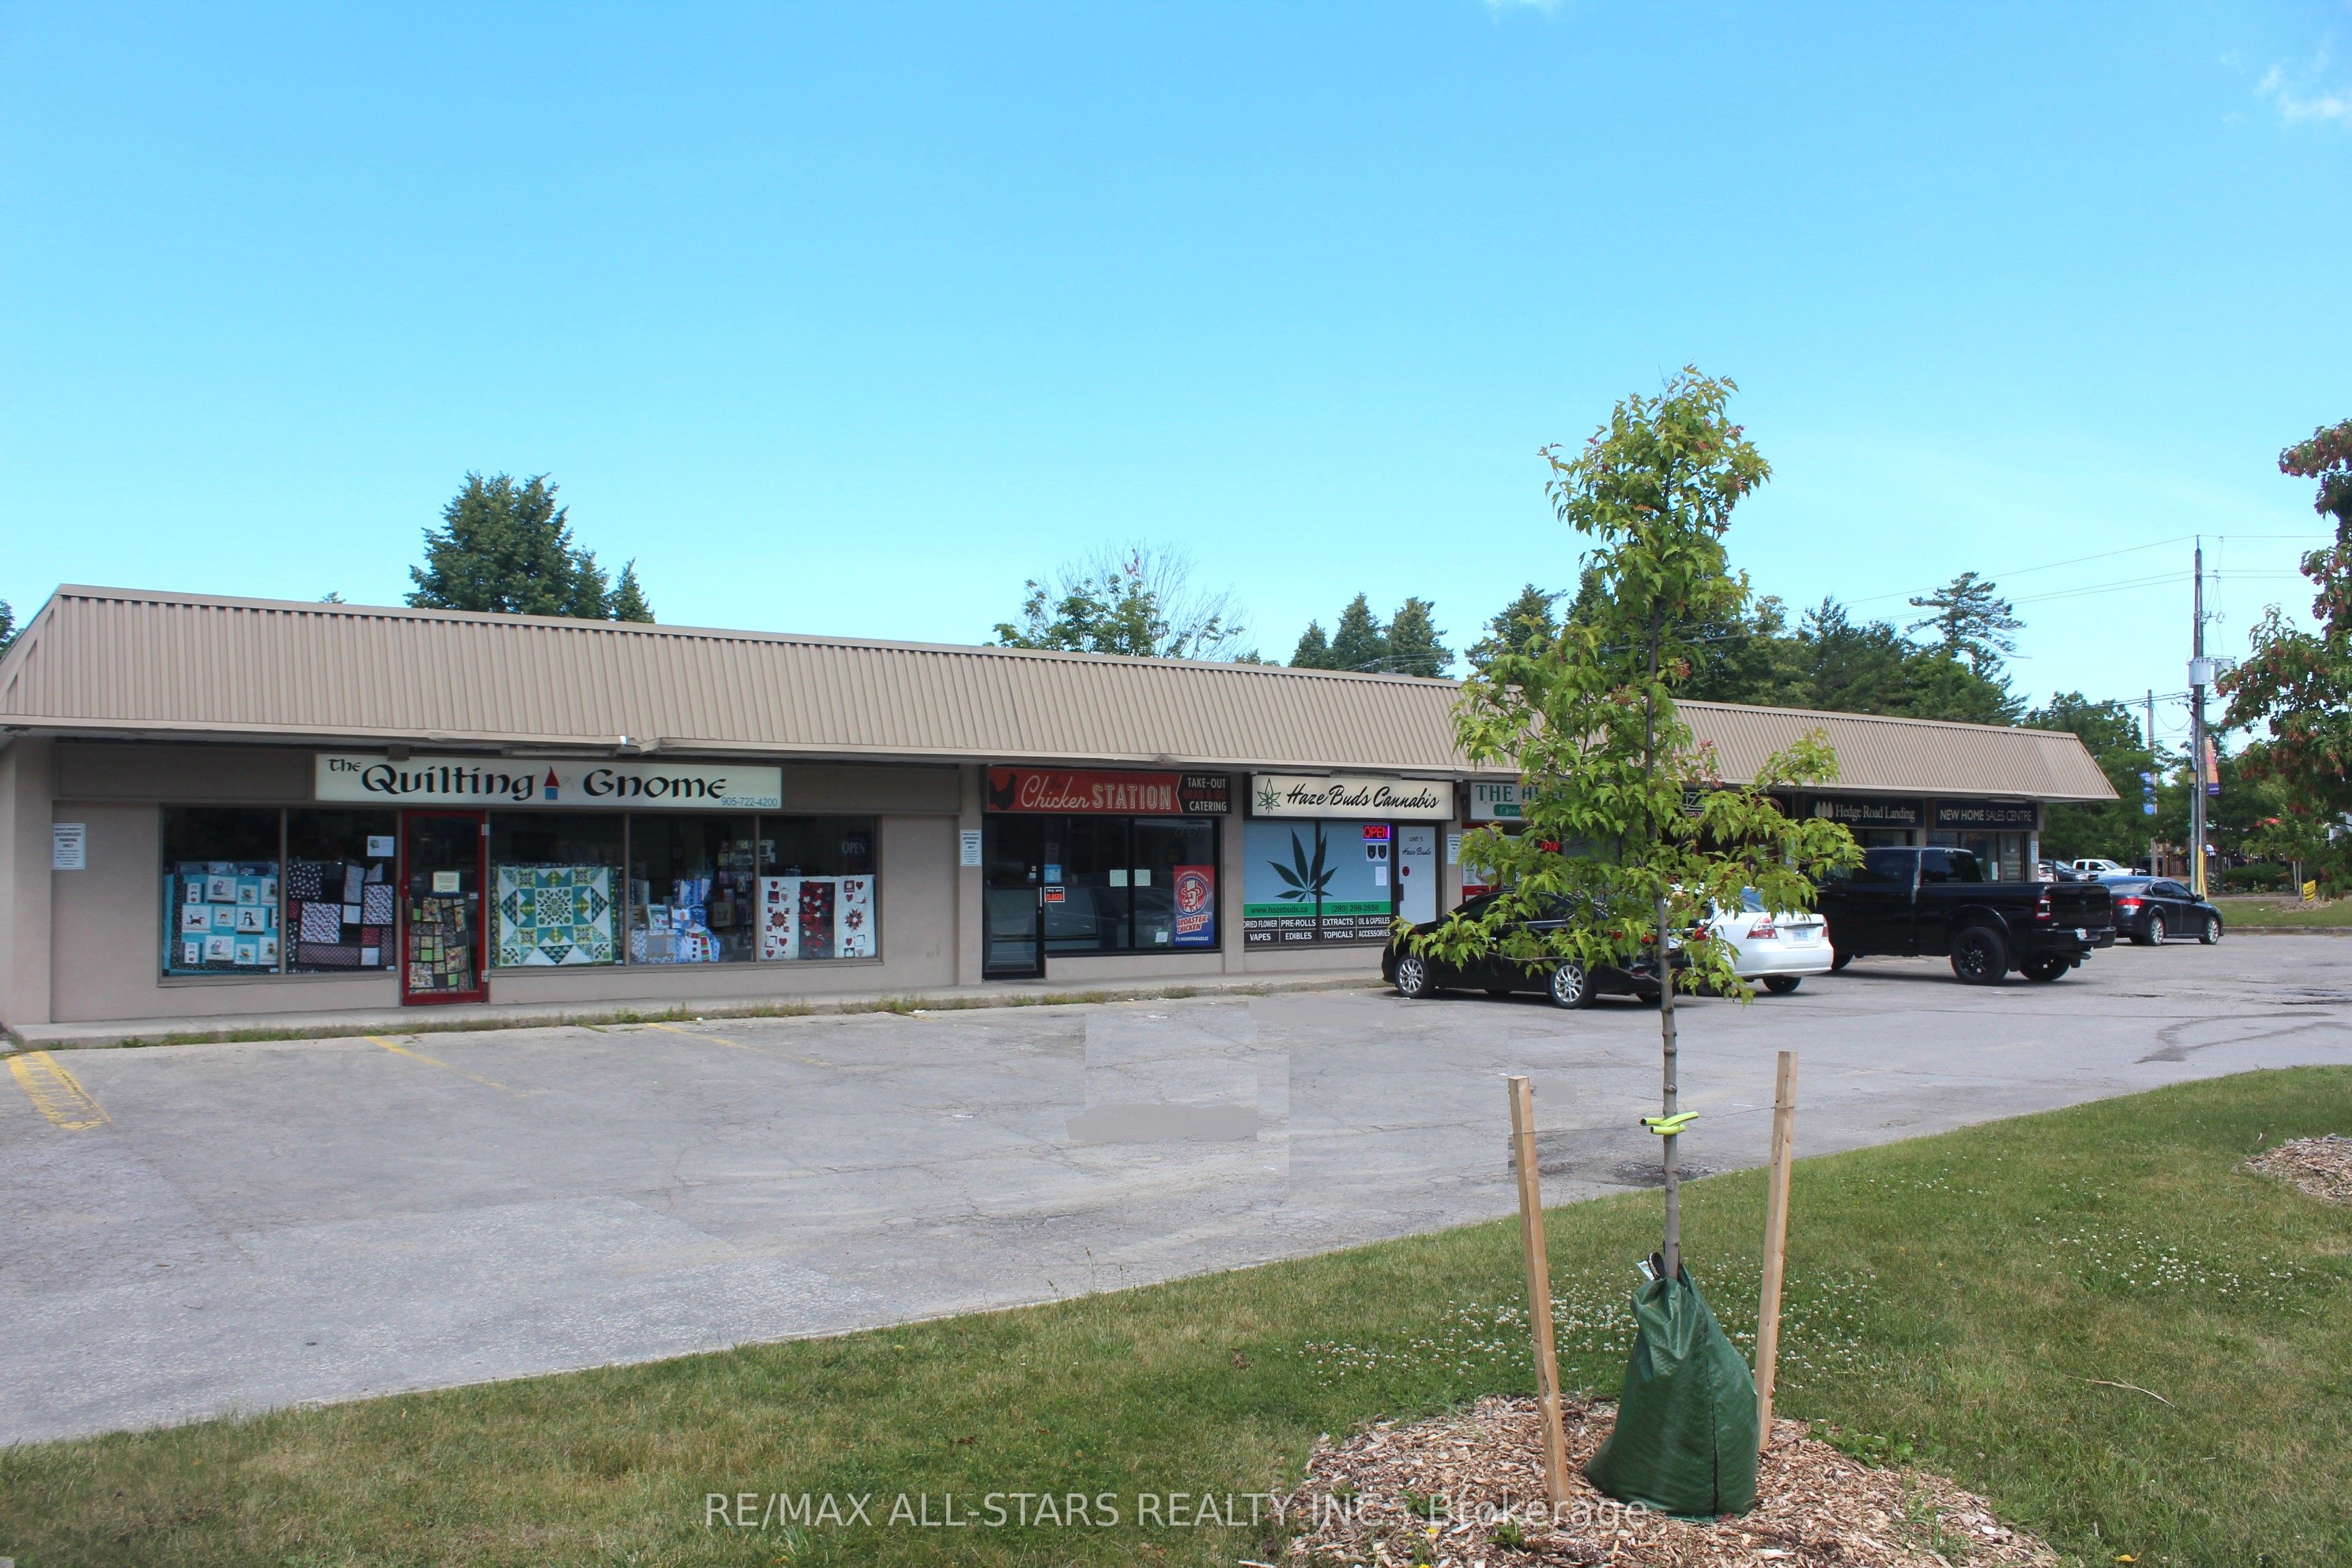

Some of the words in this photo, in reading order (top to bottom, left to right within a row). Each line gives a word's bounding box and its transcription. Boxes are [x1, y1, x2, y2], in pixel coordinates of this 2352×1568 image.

[327, 758, 361, 772] The
[361, 764, 536, 801] Quilting
[583, 768, 727, 798] Gnome
[1188, 778, 1226, 788] TAKE-OUT
[1021, 774, 1090, 808] Chicken
[1092, 783, 1171, 810] STATION
[1286, 783, 1328, 805] Haze
[1328, 785, 1372, 806] Buds
[1373, 786, 1439, 808] Cannabis
[1475, 785, 1514, 802] THE
[721, 797, 778, 807] 905-722-4200
[1190, 801, 1226, 811] CATERING
[1835, 804, 1861, 821] Hedge
[1863, 804, 1883, 818] Road
[1884, 806, 1915, 823] Landing
[1940, 809, 1959, 821] NEW
[1961, 809, 1984, 821] HOME
[1986, 810, 2004, 821] SALES
[2006, 811, 2032, 821] CENTRE
[1363, 826, 1388, 838] OPEN
[842, 841, 866, 854] OPEN
[1402, 847, 1416, 855] Haze
[1416, 847, 1431, 855] Buds
[1251, 904, 1308, 913] www.hazebuds.ca
[1331, 905, 1348, 914] (289)
[1177, 915, 1208, 926] BROASTER
[1243, 920, 1258, 928] DRIED
[1258, 919, 1277, 928] FLOWER
[1281, 919, 1316, 927] PRE-ROLLS
[1177, 924, 1201, 934] CHICKEN
[1323, 930, 1354, 938] TOPICALS
[1358, 929, 1391, 938] ACCESSORIES
[1250, 933, 1271, 941] VAPES
[1286, 932, 1312, 940] EDIBLES
